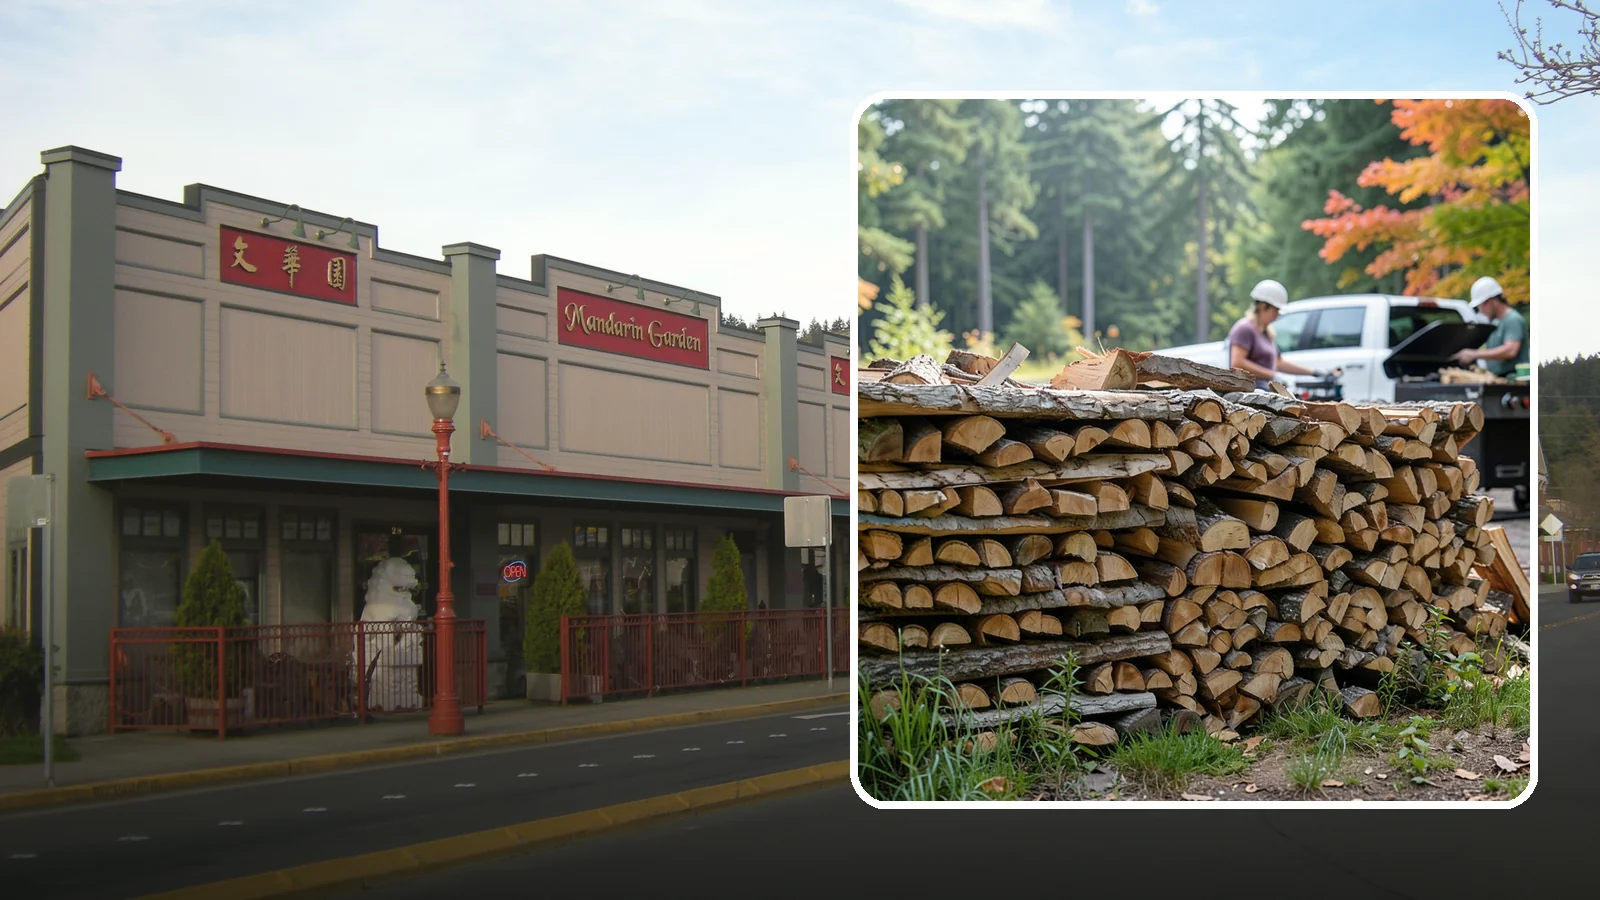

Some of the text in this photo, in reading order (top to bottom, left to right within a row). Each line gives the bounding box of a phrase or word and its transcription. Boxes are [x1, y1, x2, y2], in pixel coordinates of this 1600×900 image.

[230, 235, 346, 291] 文華園
[564, 302, 702, 352] Mandarin Garden
[503, 565, 527, 578] OPEN
